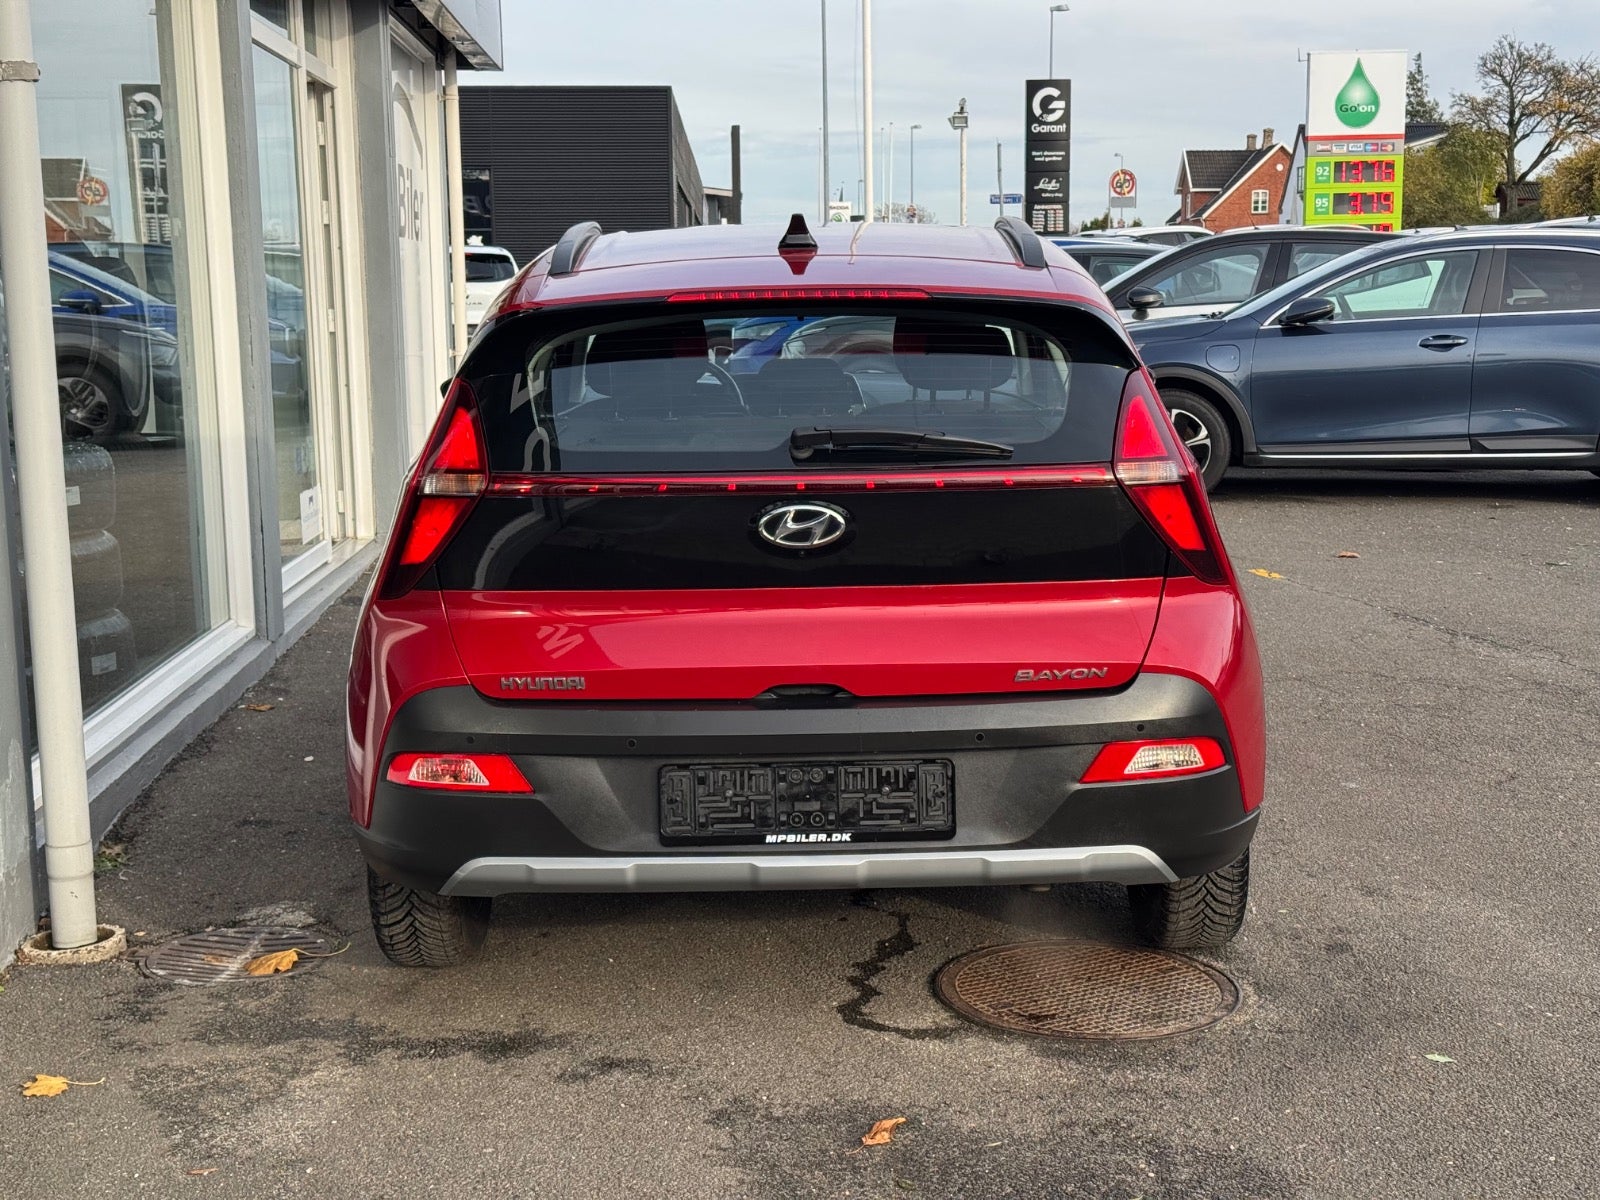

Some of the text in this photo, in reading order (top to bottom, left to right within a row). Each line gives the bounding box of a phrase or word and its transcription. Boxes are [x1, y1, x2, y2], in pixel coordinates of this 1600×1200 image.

[1031, 123, 1066, 133] Garant
[1316, 166, 1330, 176] 92
[397, 163, 423, 242] Biler
[1315, 198, 1329, 208] 95
[1014, 666, 1108, 682] BAYON
[500, 676, 585, 690] HYUNDAI
[765, 832, 853, 843] MPBILER.DK
